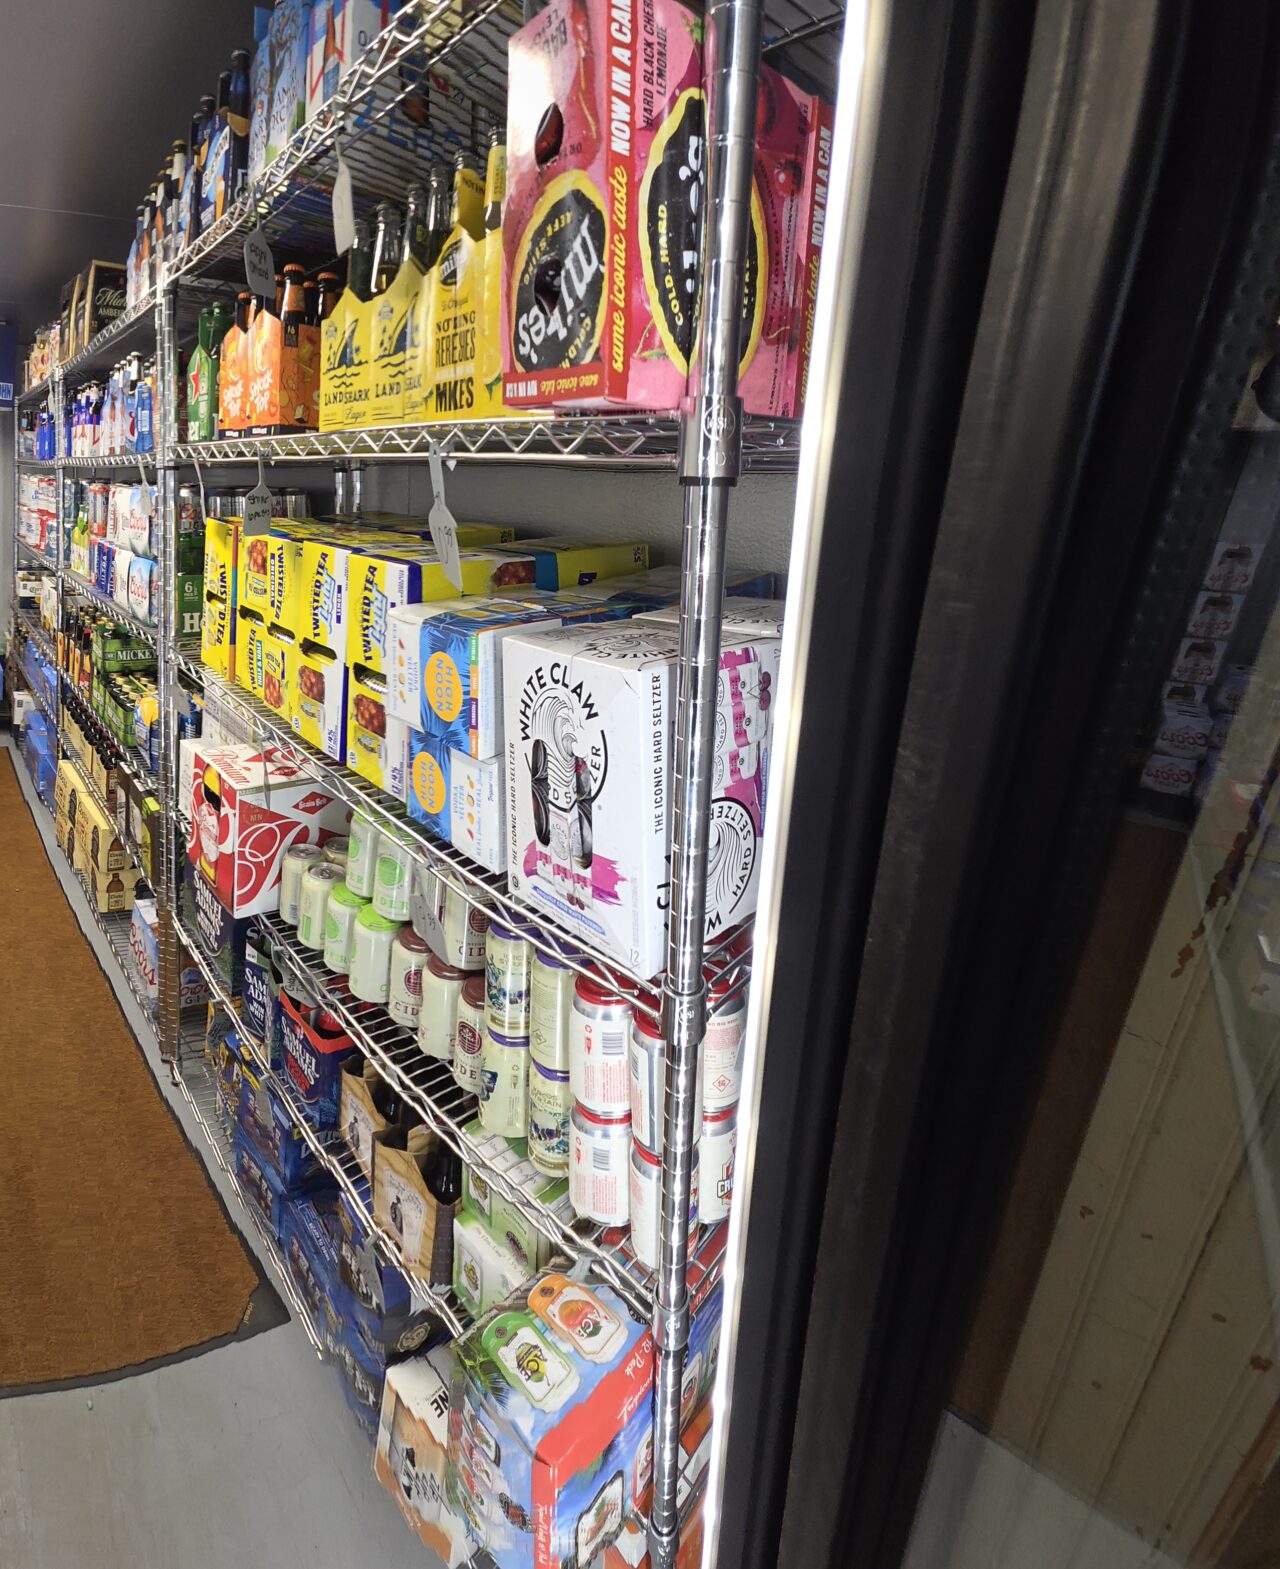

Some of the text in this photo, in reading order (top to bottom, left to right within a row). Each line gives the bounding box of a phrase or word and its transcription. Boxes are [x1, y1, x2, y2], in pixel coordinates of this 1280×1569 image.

[611, 67, 631, 97] IN
[612, 47, 631, 66] A
[643, 40, 654, 86] BLACK
[656, 25, 667, 97] LEMONADE
[610, 98, 631, 157] NOW
[643, 88, 653, 127] HARD
[810, 126, 833, 247] NOW IN A CAN
[609, 166, 628, 372] same iconic taste
[185, 582, 193, 592] 6
[274, 545, 284, 619] TWISTED TEA
[312, 552, 329, 638] TWISTED TEA
[363, 565, 378, 662] TWISTED TEA
[247, 628, 257, 690] TWISTED TEA
[436, 658, 444, 712] NOON
[444, 665, 454, 713] HIGH
[519, 662, 600, 741] WHITE CLAW
[508, 741, 516, 785] SELTZER
[652, 674, 664, 835] THE ICONIC HARD SELTZER
[419, 761, 427, 800] HIGH
[427, 761, 436, 808] NOON
[509, 817, 517, 849] ICONIC
[576, 1309, 600, 1340] ACE
